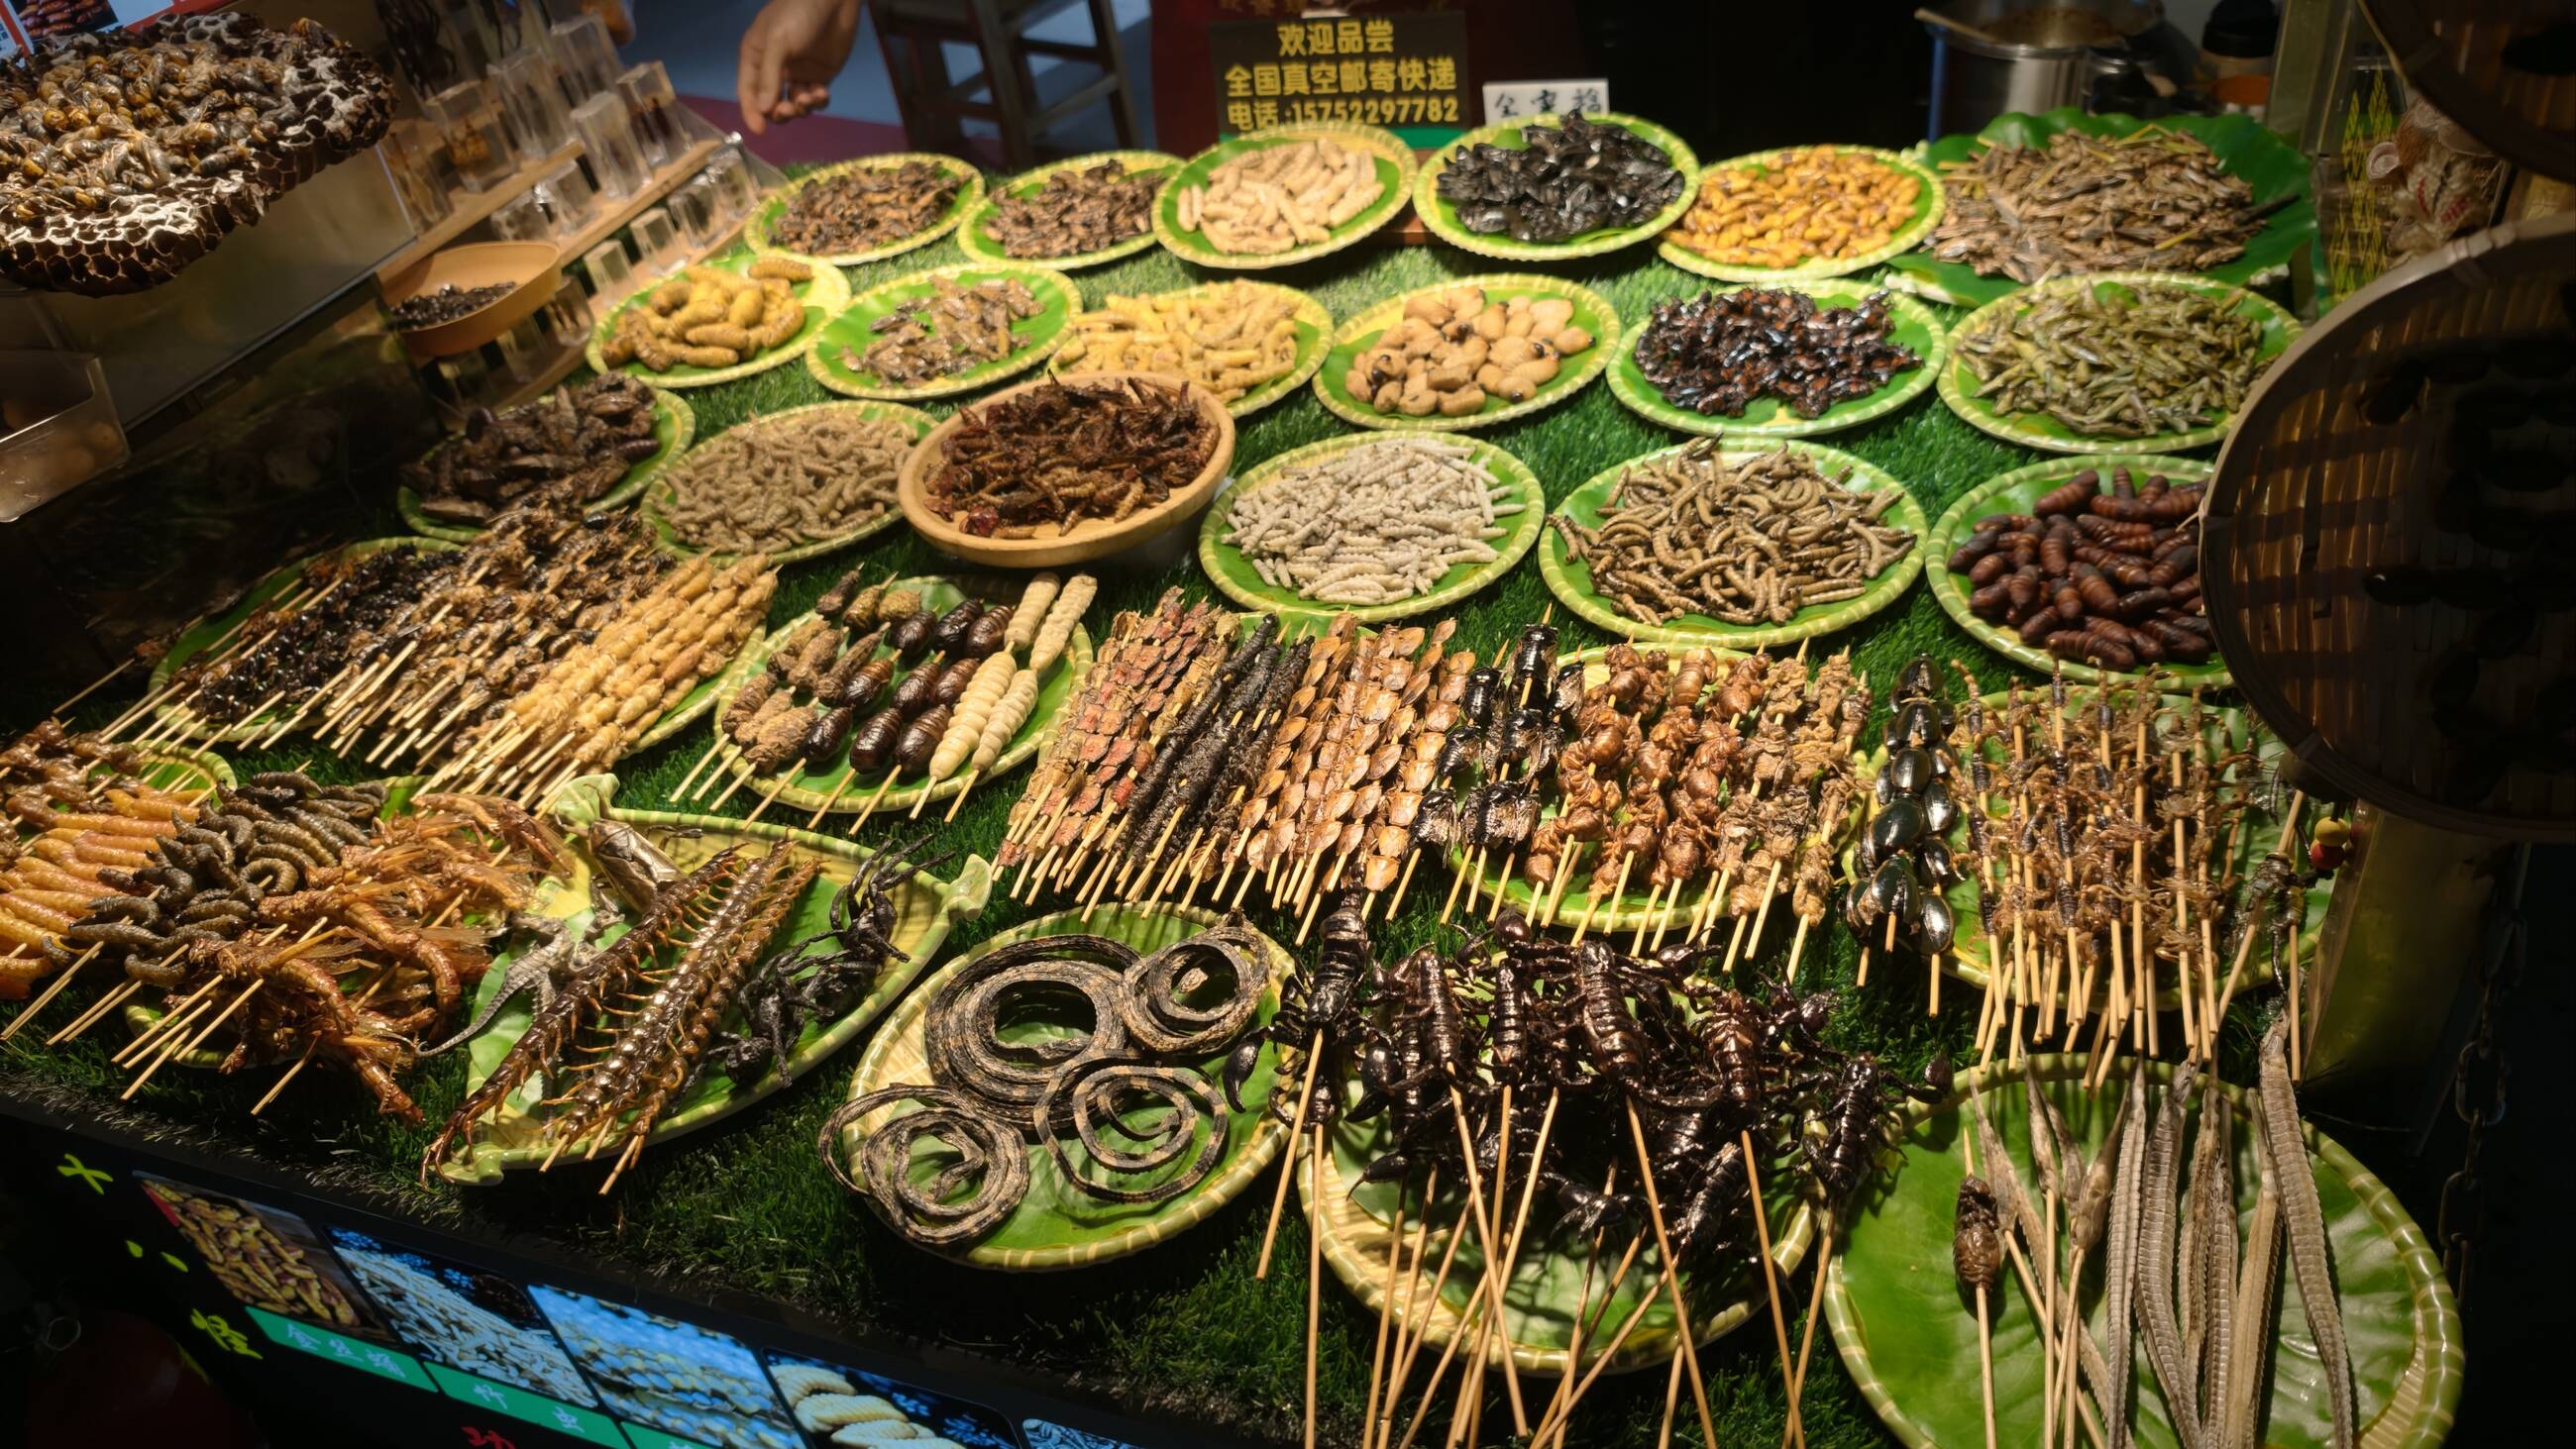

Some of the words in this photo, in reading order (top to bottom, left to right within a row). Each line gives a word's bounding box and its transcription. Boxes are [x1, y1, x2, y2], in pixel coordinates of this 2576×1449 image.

[1277, 18, 1395, 56] 欢迎品尝
[1225, 53, 1458, 97] 全国真空邮寄快递
